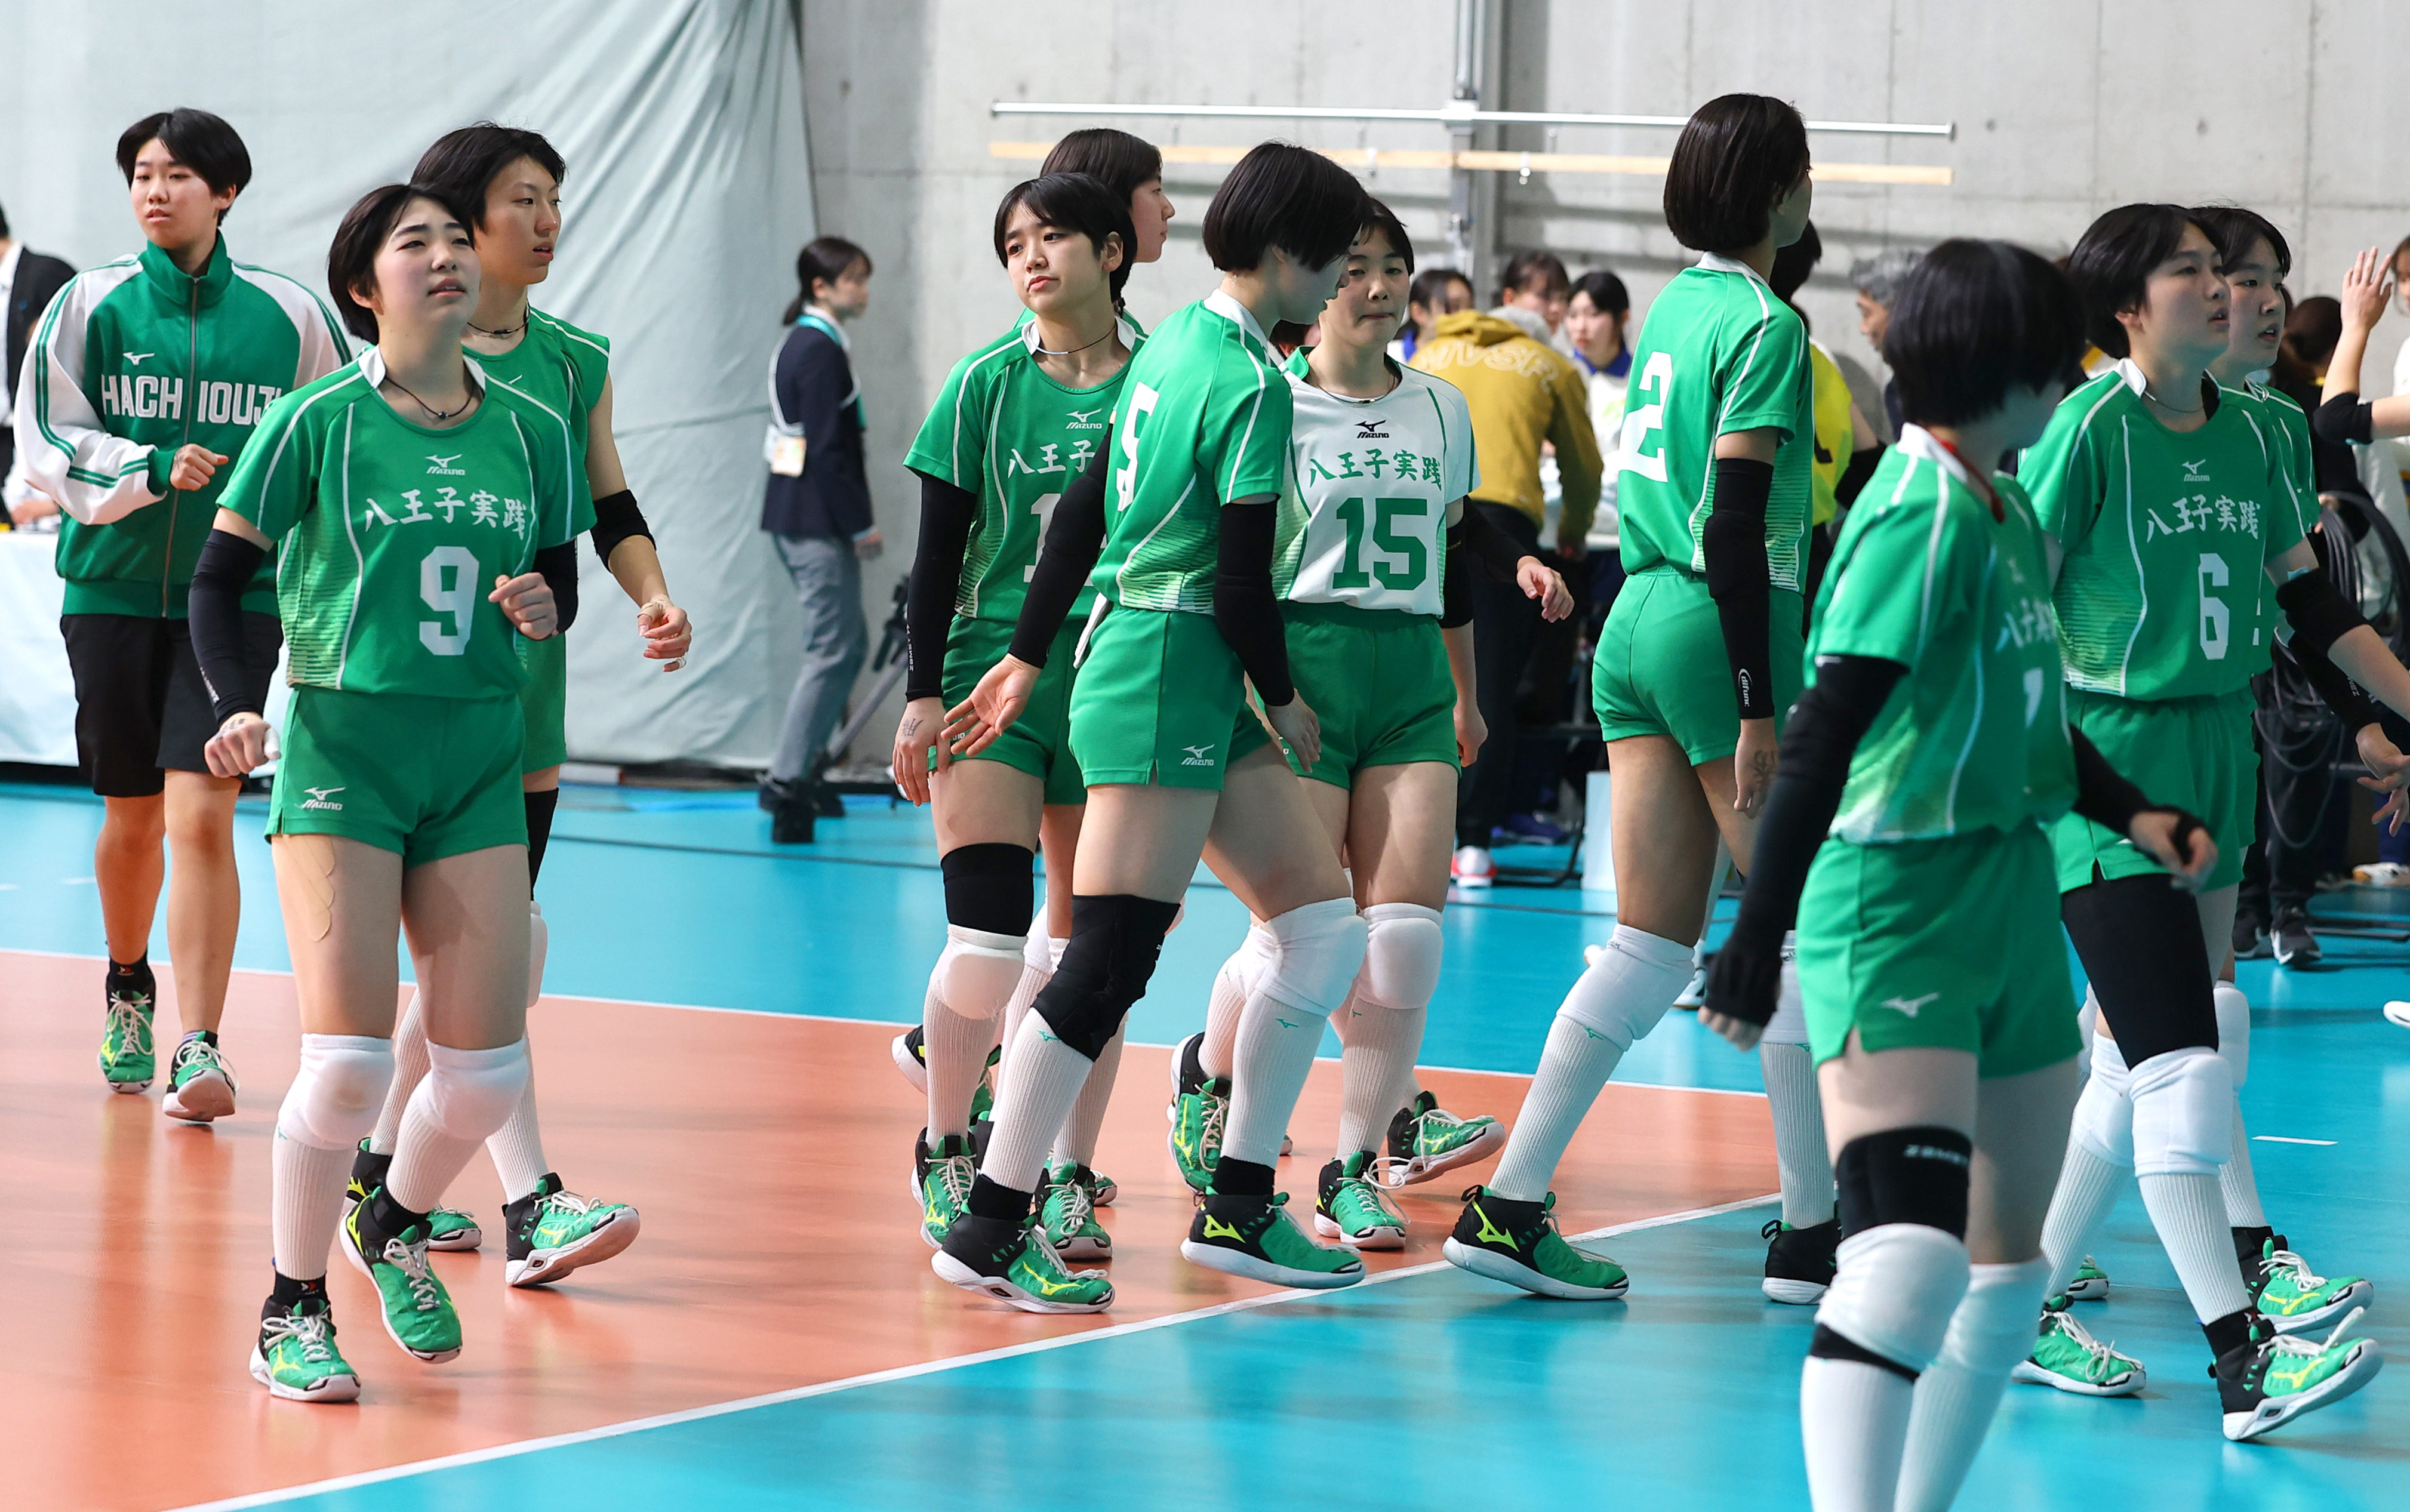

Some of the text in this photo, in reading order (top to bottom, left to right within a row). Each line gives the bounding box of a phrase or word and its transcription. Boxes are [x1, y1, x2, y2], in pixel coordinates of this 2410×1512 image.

[1116, 380, 1160, 512] 5
[1618, 350, 1673, 483] 2
[365, 486, 527, 540] 八王子実践
[1309, 448, 1442, 491] 八王子実践
[2147, 494, 2261, 543] 八王子実践
[1332, 497, 1427, 591] 15
[419, 546, 480, 656] 9
[2197, 553, 2230, 660] 6
